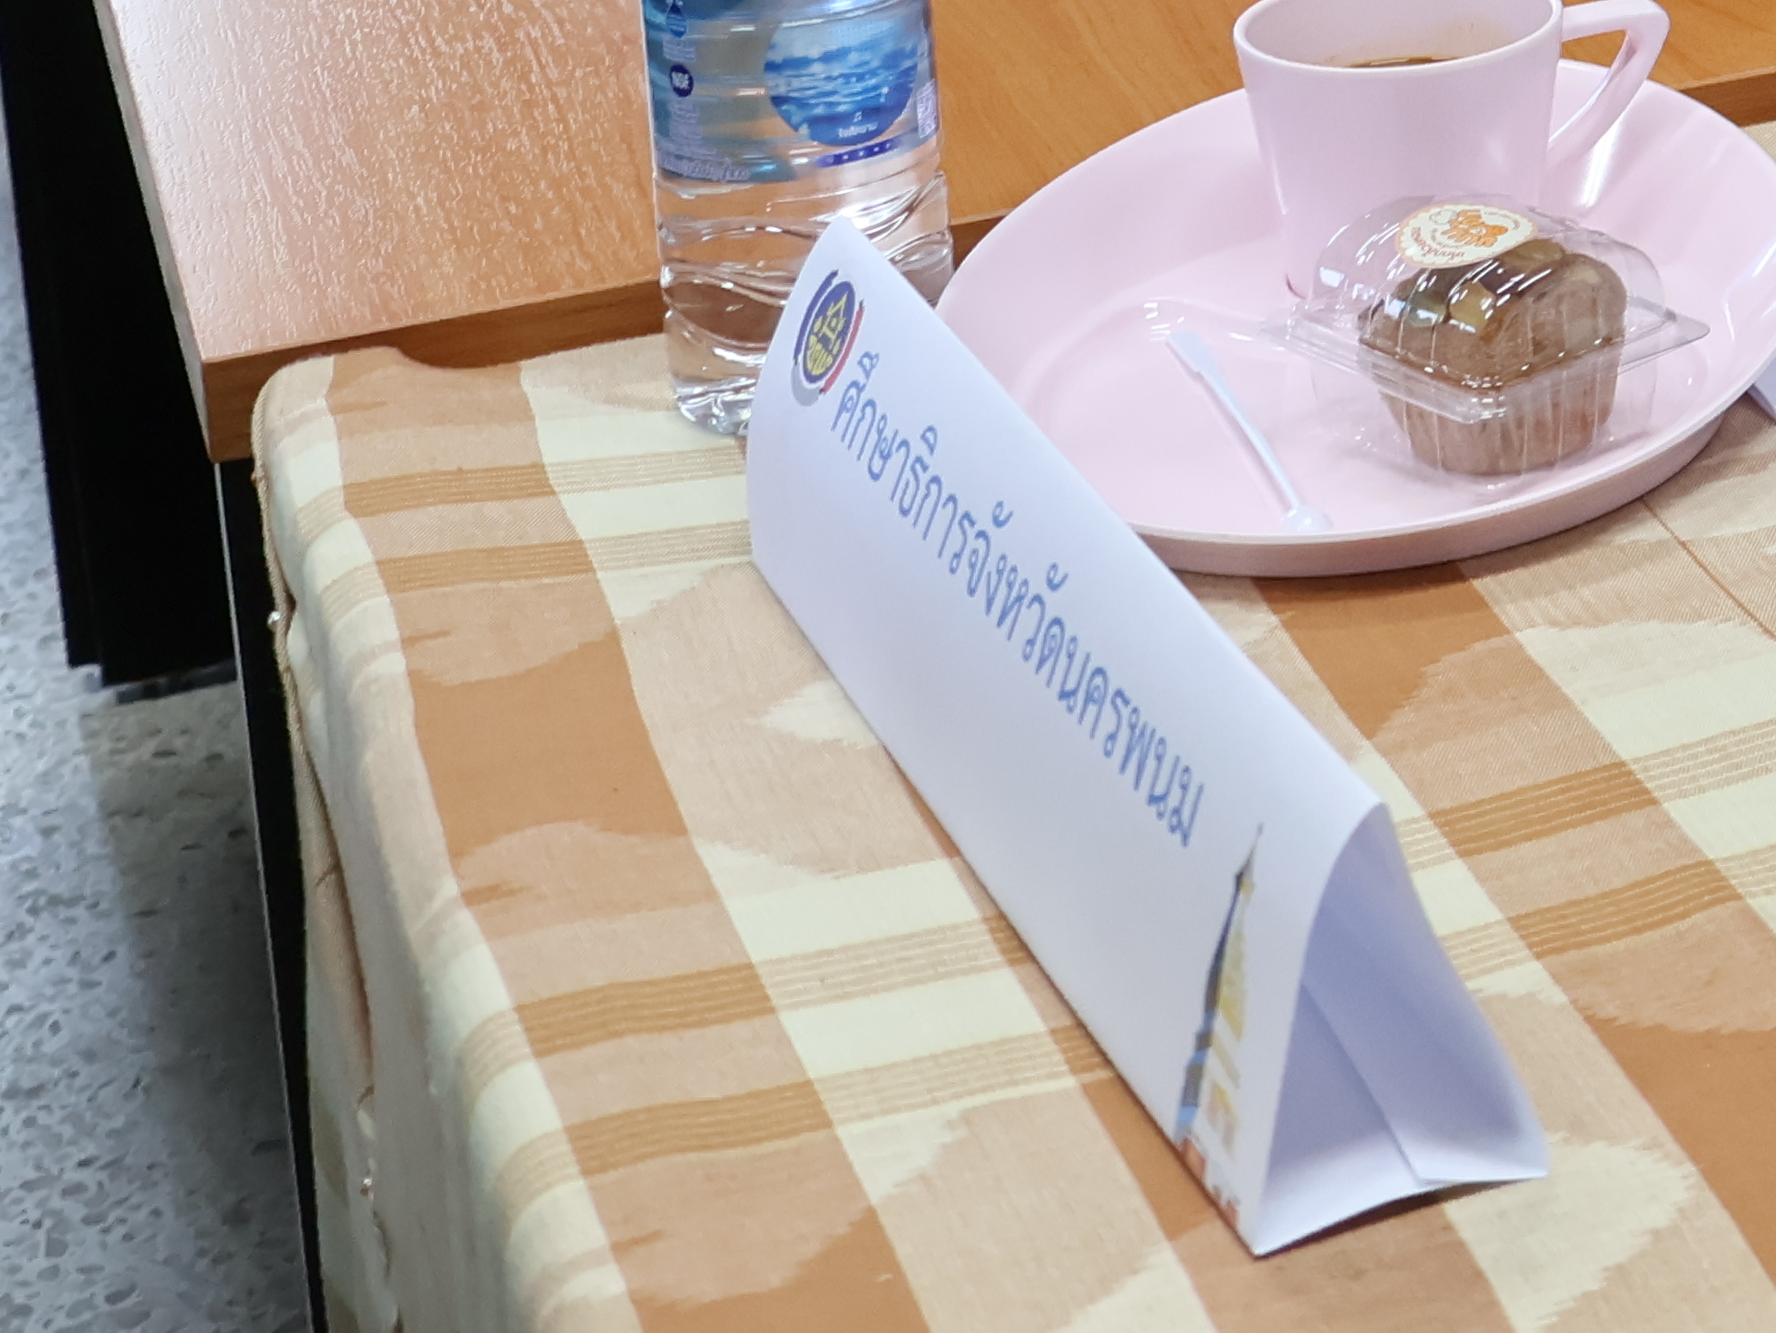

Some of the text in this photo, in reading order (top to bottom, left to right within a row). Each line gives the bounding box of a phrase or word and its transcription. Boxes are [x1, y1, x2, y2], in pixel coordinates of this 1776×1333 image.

[830, 351, 1204, 849] ศึกษาธิการจังหวัดนครพนม
